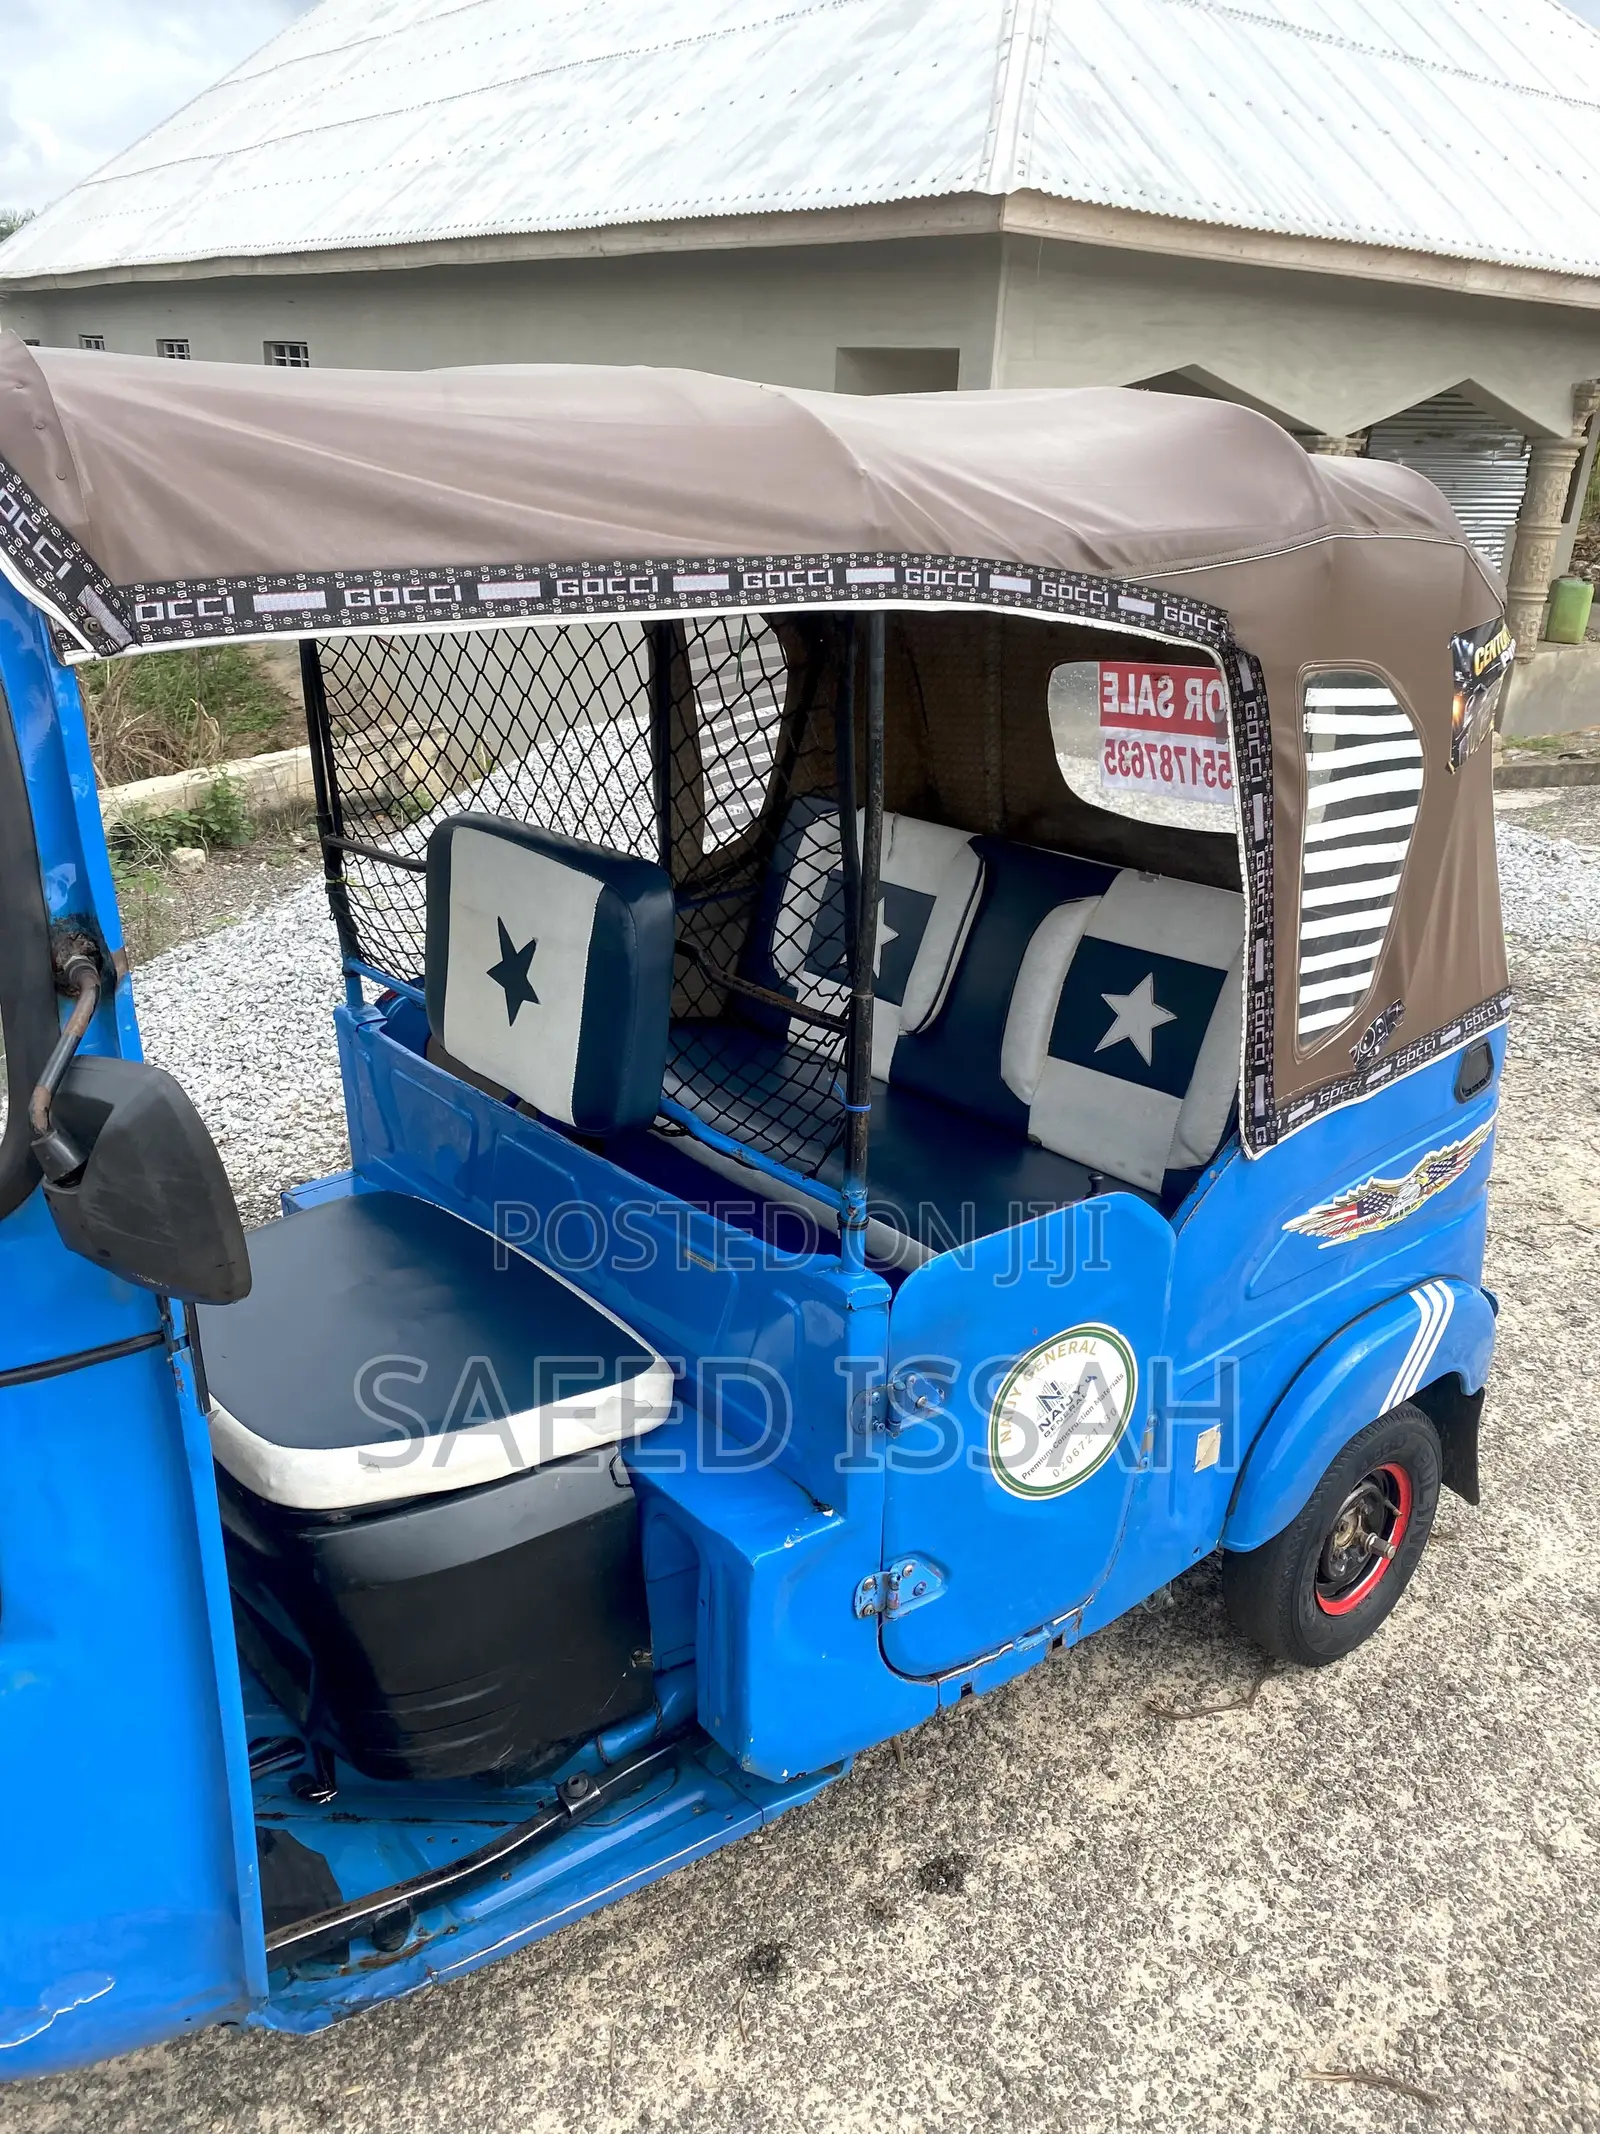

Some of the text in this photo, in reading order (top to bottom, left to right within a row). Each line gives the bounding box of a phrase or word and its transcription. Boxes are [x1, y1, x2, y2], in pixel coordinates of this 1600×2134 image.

[343, 585, 462, 608] GOCCI
[556, 574, 659, 597] GOCCI
[742, 568, 834, 589] GOCCI
[905, 568, 979, 588] GOCCI
[1041, 580, 1109, 607] GOCCI
[1244, 701, 1263, 783] GOCCI
[1256, 850, 1265, 930] GOCCI
[1254, 991, 1266, 1066] GOCCI
[1396, 1039, 1437, 1068] GOCCI
[1464, 1004, 1498, 1031] GOCCI
[1023, 1340, 1098, 1381] GENERAL
[1021, 1448, 1054, 1480] Premium
[1052, 1405, 1095, 1449] Construction
[1093, 1373, 1125, 1406] Materials
